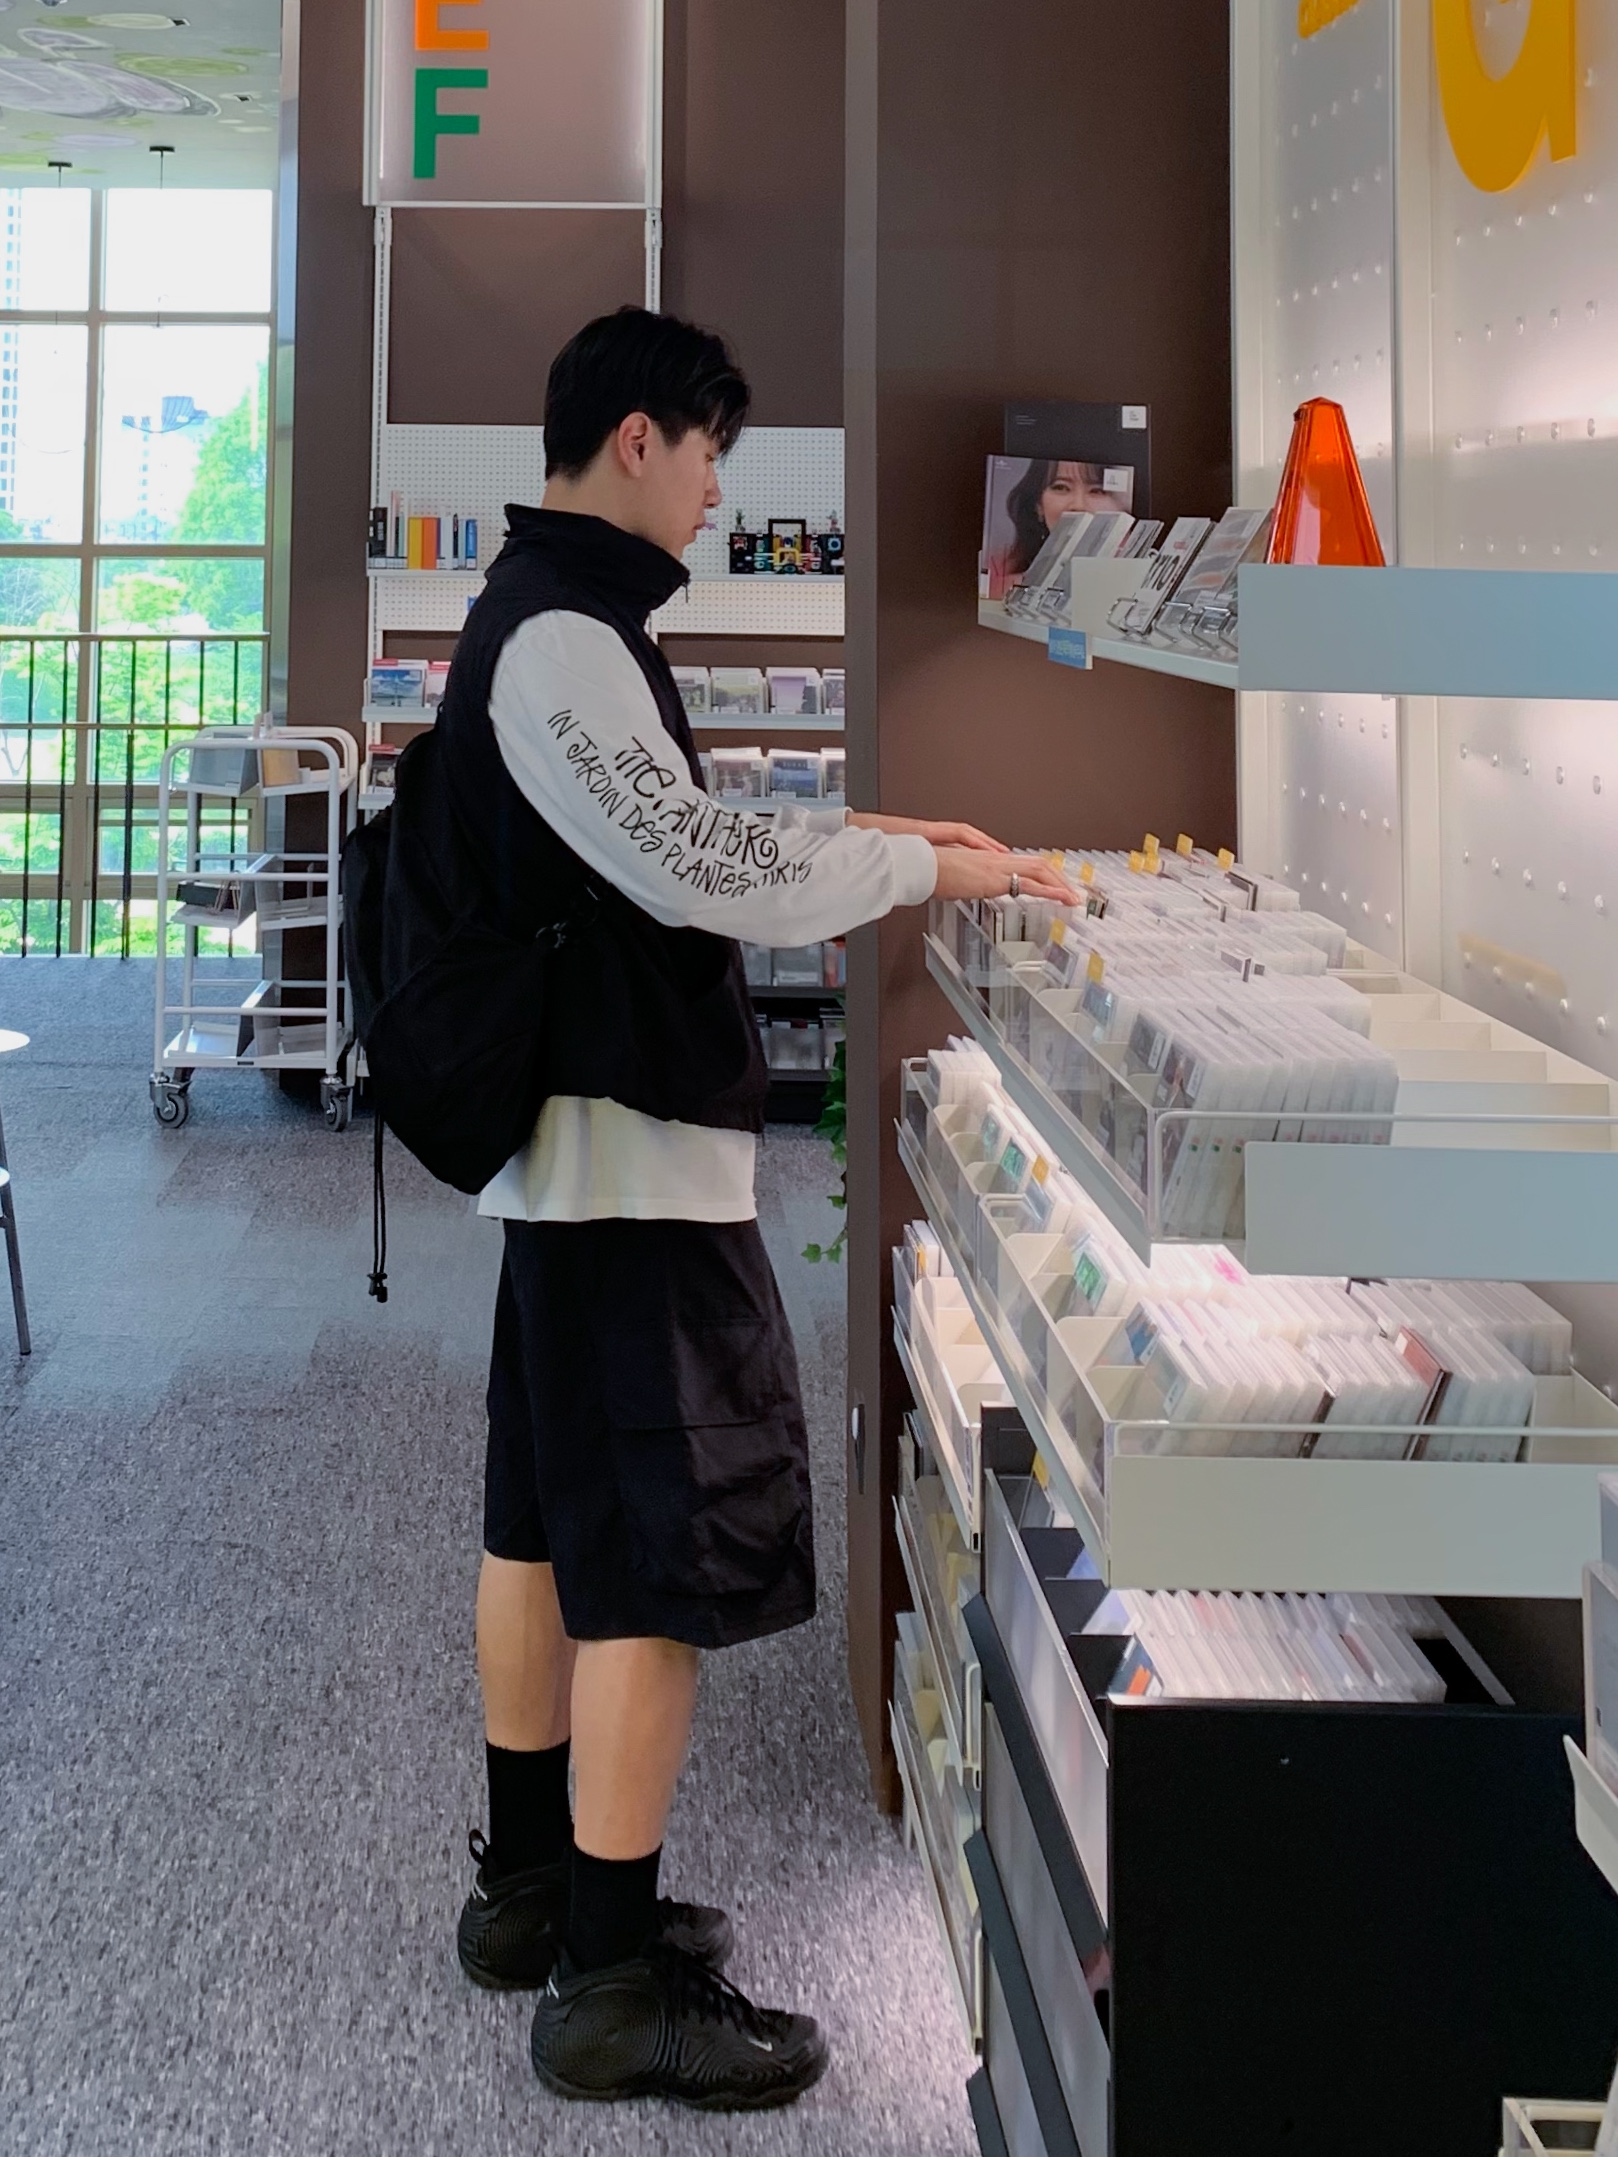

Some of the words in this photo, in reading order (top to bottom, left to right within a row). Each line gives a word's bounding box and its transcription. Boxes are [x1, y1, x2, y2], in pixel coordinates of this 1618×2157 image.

[413, 68, 488, 178] F
[547, 709, 581, 740] IN
[566, 731, 630, 819] JARDIN
